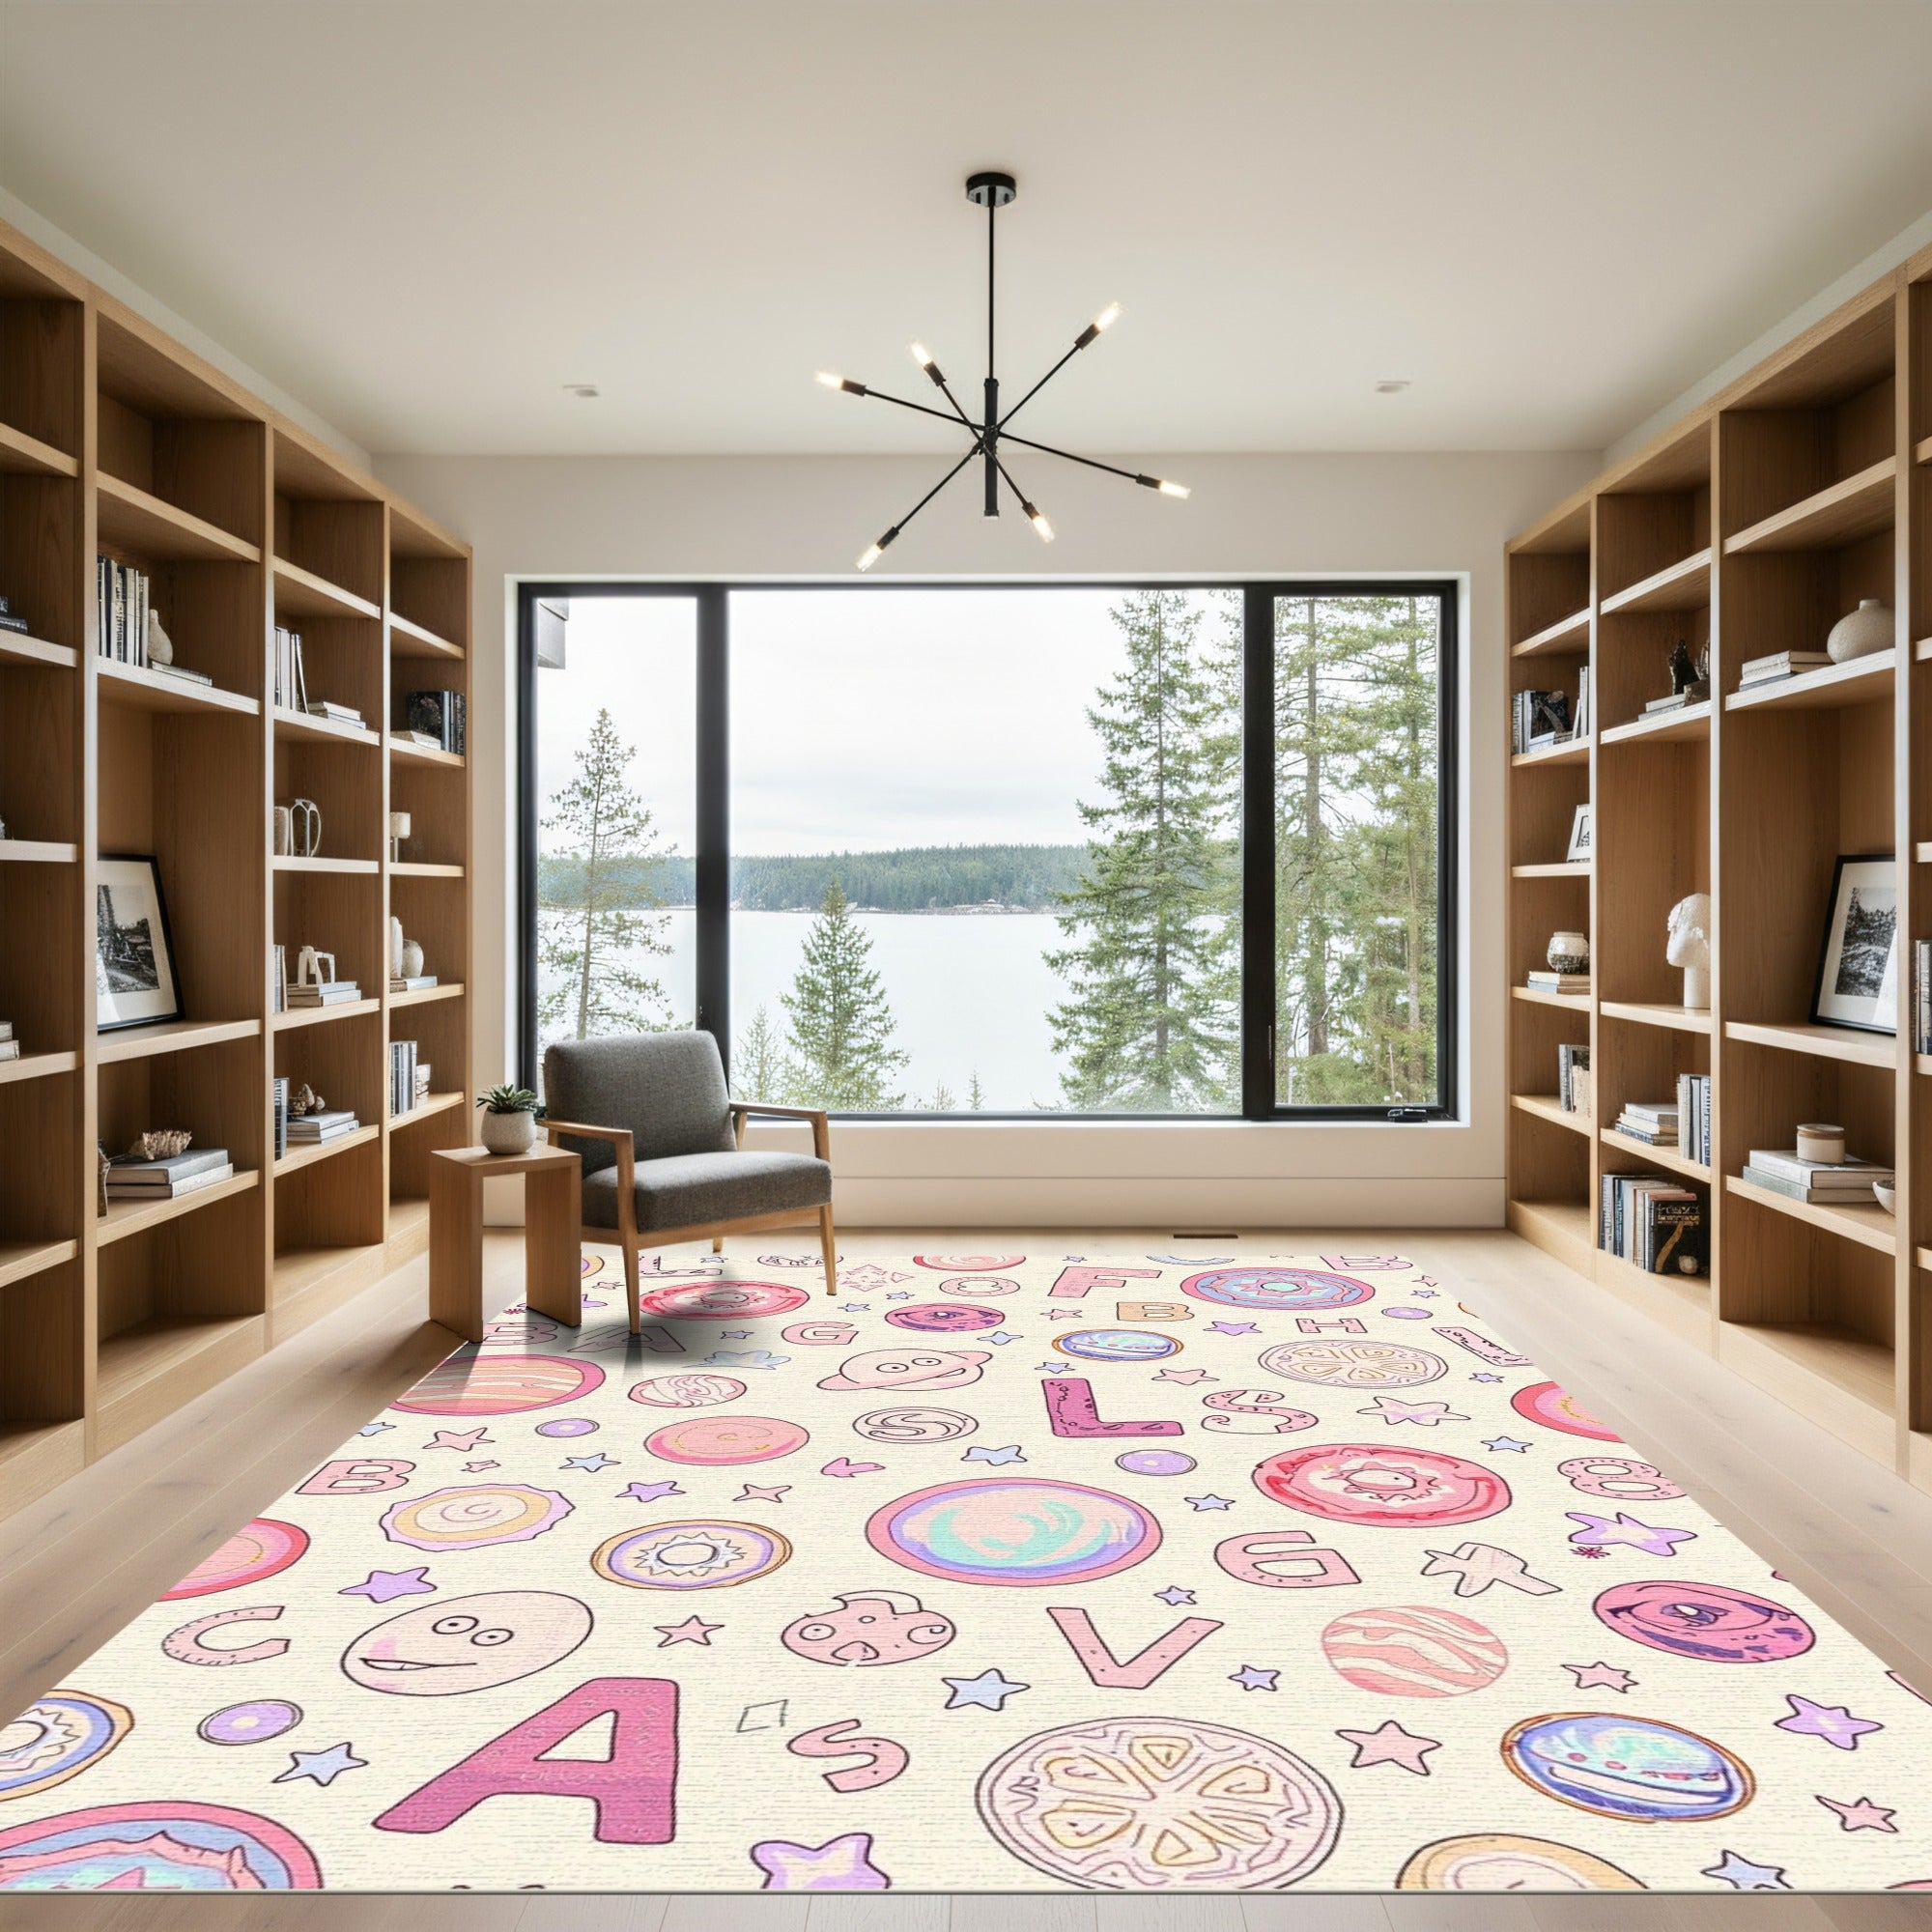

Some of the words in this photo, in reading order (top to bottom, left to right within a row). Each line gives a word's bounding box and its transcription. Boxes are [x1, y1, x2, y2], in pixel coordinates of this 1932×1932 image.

[1047, 1265, 1163, 1298] F
[1116, 1301, 1196, 1322] B
[1295, 1318, 1369, 1334] H
[483, 1321, 558, 1346] B
[566, 1324, 687, 1352] A
[781, 1321, 860, 1346] G
[1040, 1378, 1185, 1438] L
[1200, 1389, 1320, 1435] S
[294, 1458, 417, 1495] B
[1557, 1457, 1688, 1501] 8
[160, 1605, 291, 1666] C
[1046, 1606, 1225, 1690] V
[371, 1676, 680, 1845] A
[787, 1719, 910, 1793] S
